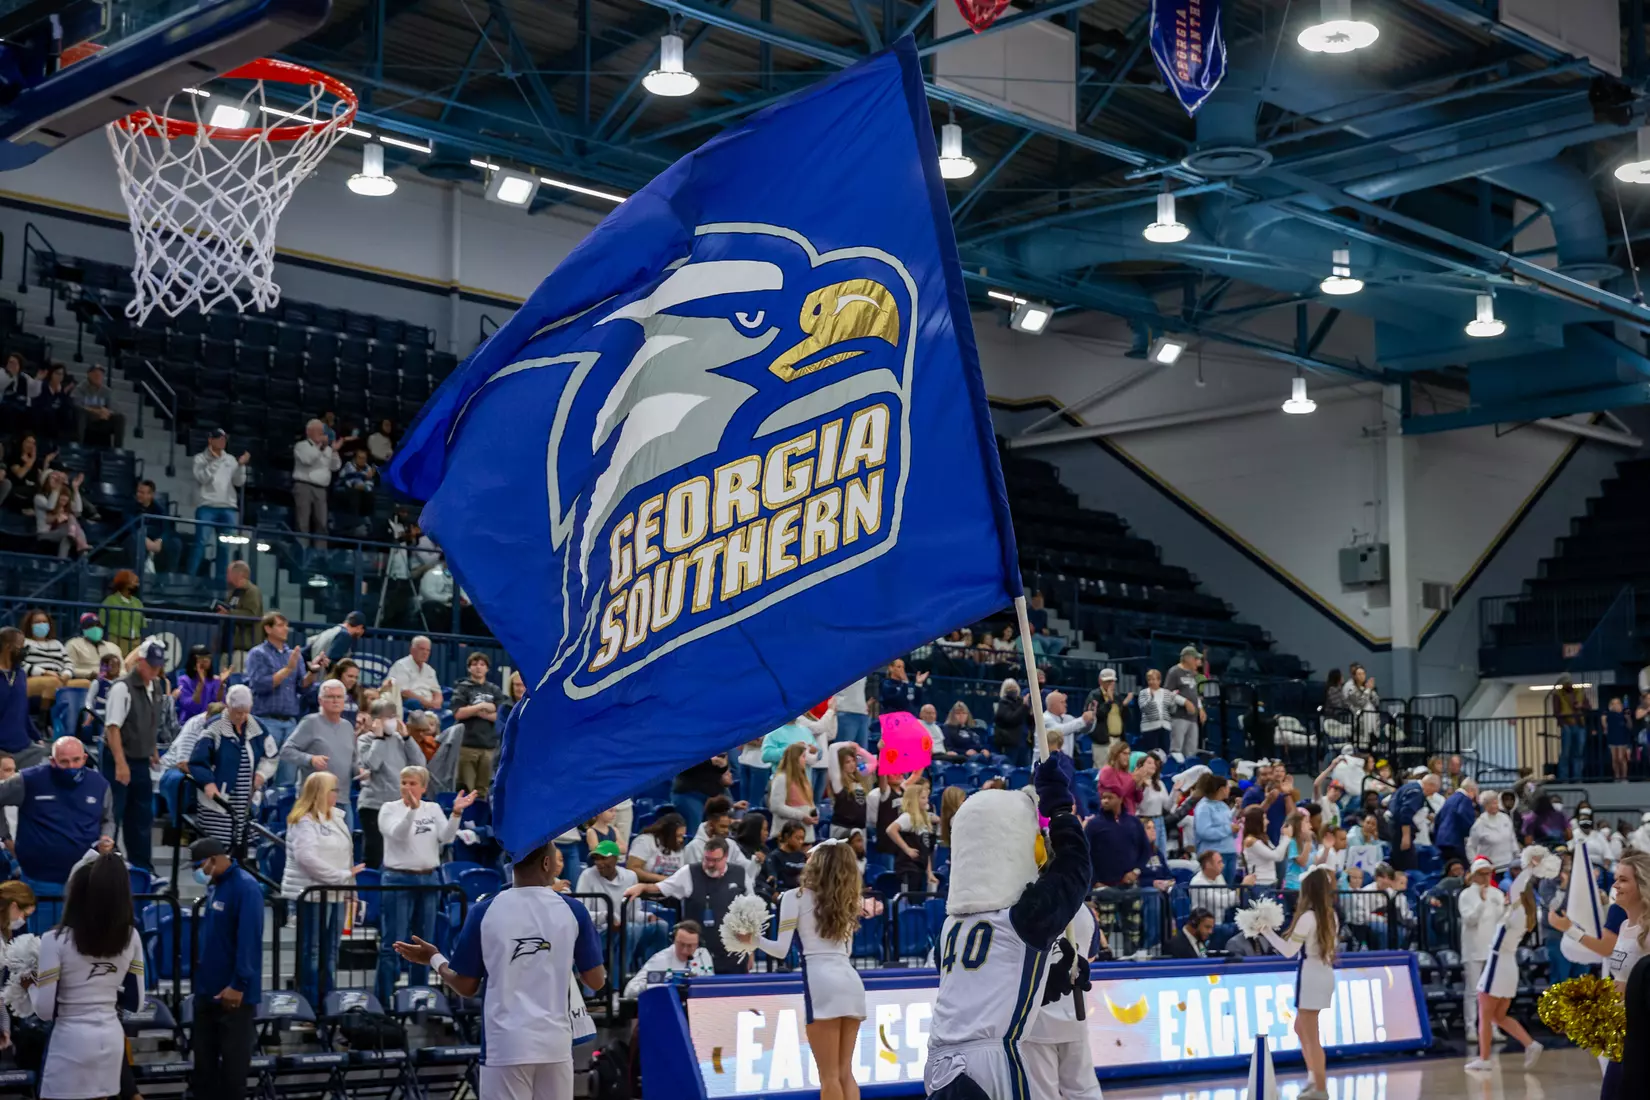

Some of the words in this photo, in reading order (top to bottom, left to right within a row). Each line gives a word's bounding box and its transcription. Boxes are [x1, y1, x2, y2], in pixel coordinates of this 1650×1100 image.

[1175, 9, 1190, 82] GEORGIA
[609, 403, 890, 595] GEORGIA
[587, 467, 886, 673] SOUTHERN
[942, 920, 994, 975] 40
